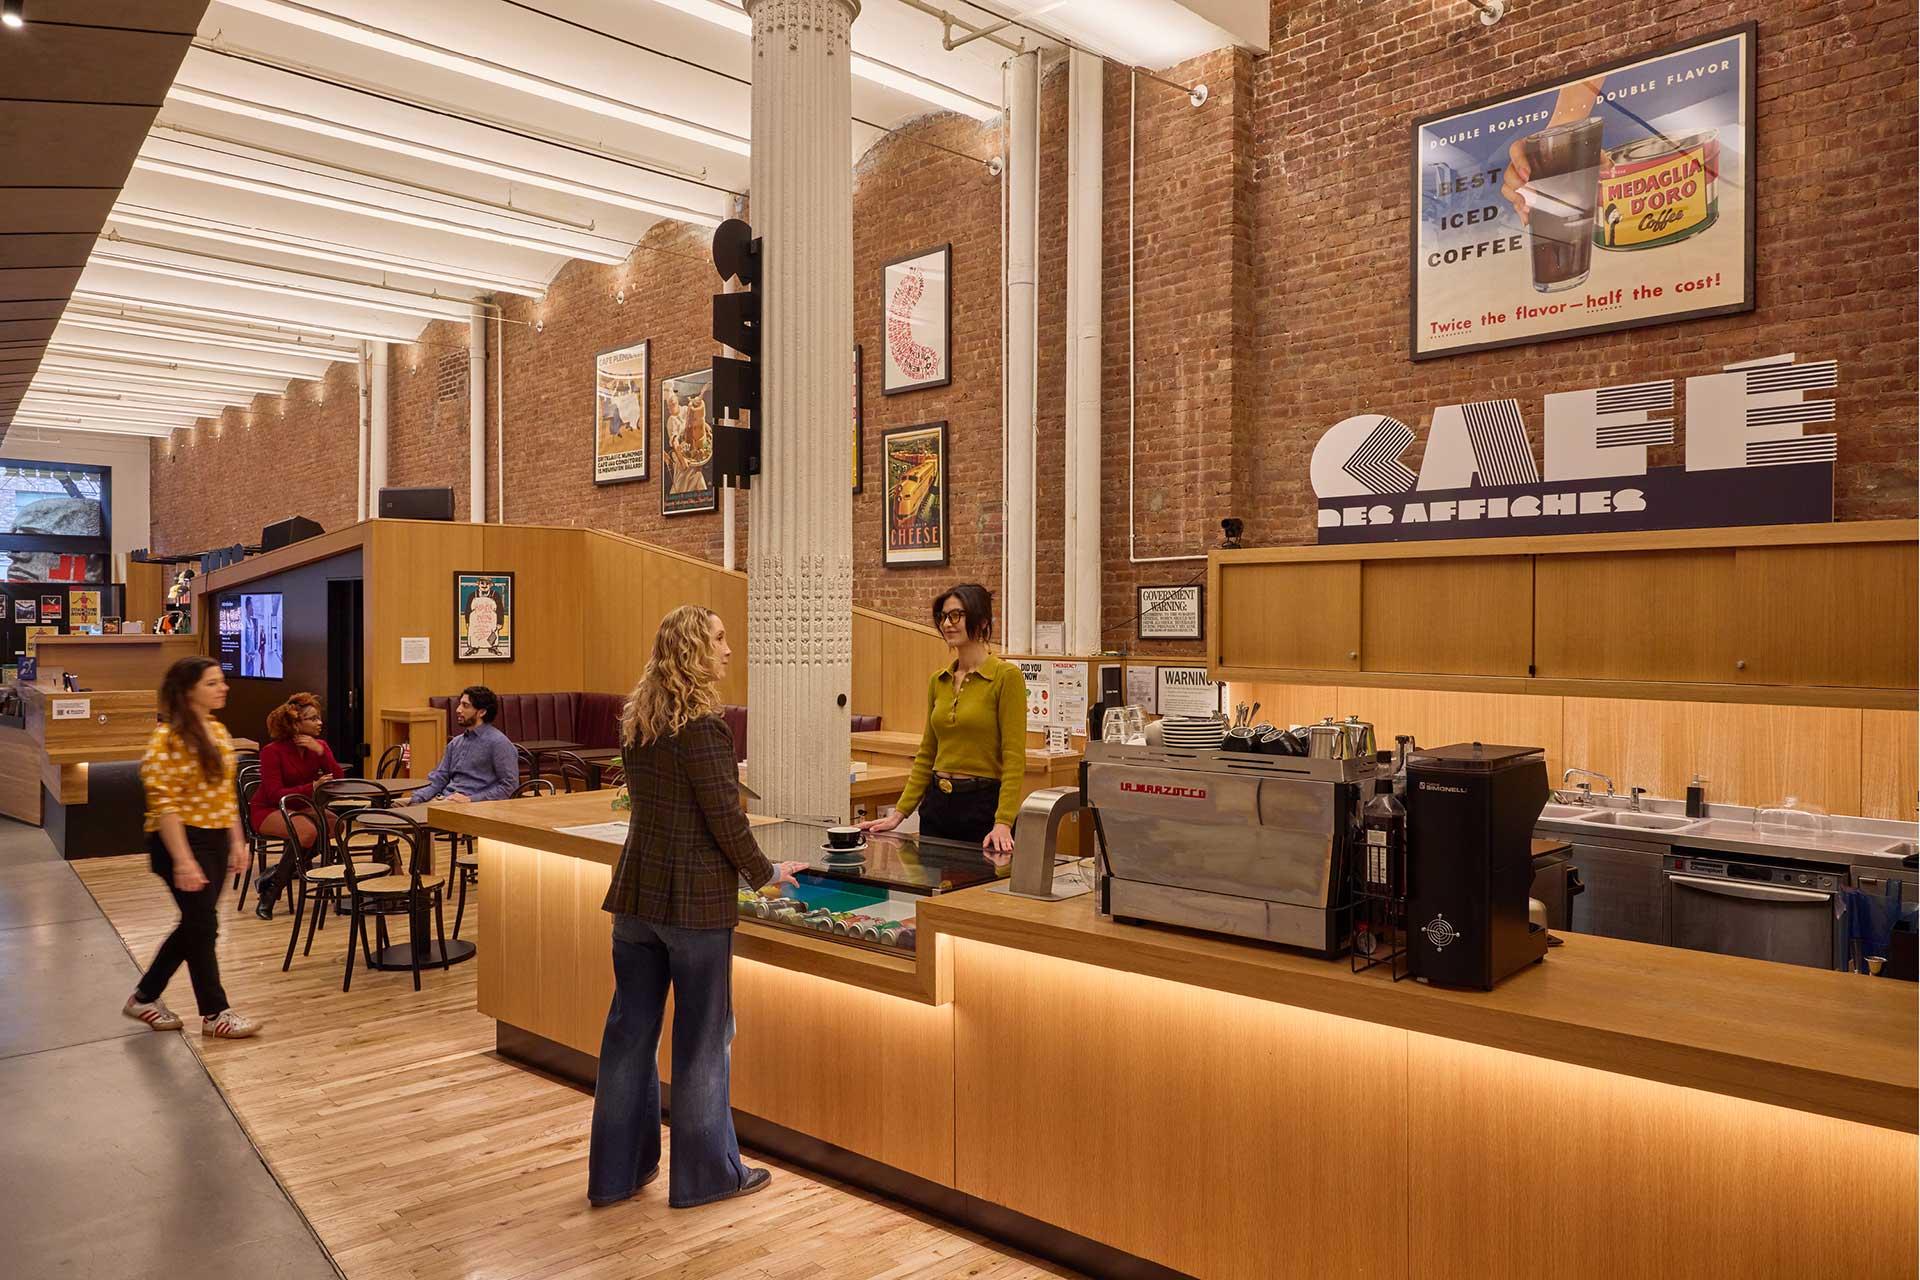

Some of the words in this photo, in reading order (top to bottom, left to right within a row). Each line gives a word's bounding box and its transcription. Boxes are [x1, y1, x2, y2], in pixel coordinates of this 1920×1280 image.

[1596, 80, 1656, 105] DOUBLE
[1667, 60, 1730, 85] FLAVOR
[1430, 128, 1481, 149] DOUBLE
[1489, 110, 1549, 133] ROASTED
[1439, 168, 1502, 197] BEST
[1607, 158, 1702, 201] MEDAGLIA
[1630, 180, 1697, 216] D'ORO
[1441, 205, 1499, 231] ICED
[1638, 208, 1685, 233] Coffee
[1427, 235, 1523, 268] COFFEE
[1430, 317, 1472, 335] Twice
[1481, 311, 1507, 326] the
[1632, 285, 1663, 301] the
[1674, 272, 1721, 294] cost!
[1317, 504, 1394, 528] DES
[1401, 488, 1647, 524] AFFICHES
[891, 526, 939, 546] CHEESE
[1142, 589, 1195, 601] GOVERNMENT
[1150, 601, 1188, 612] WARNING:
[1020, 663, 1030, 672] DID
[1030, 663, 1042, 672] YOU
[1023, 672, 1038, 681] NOW
